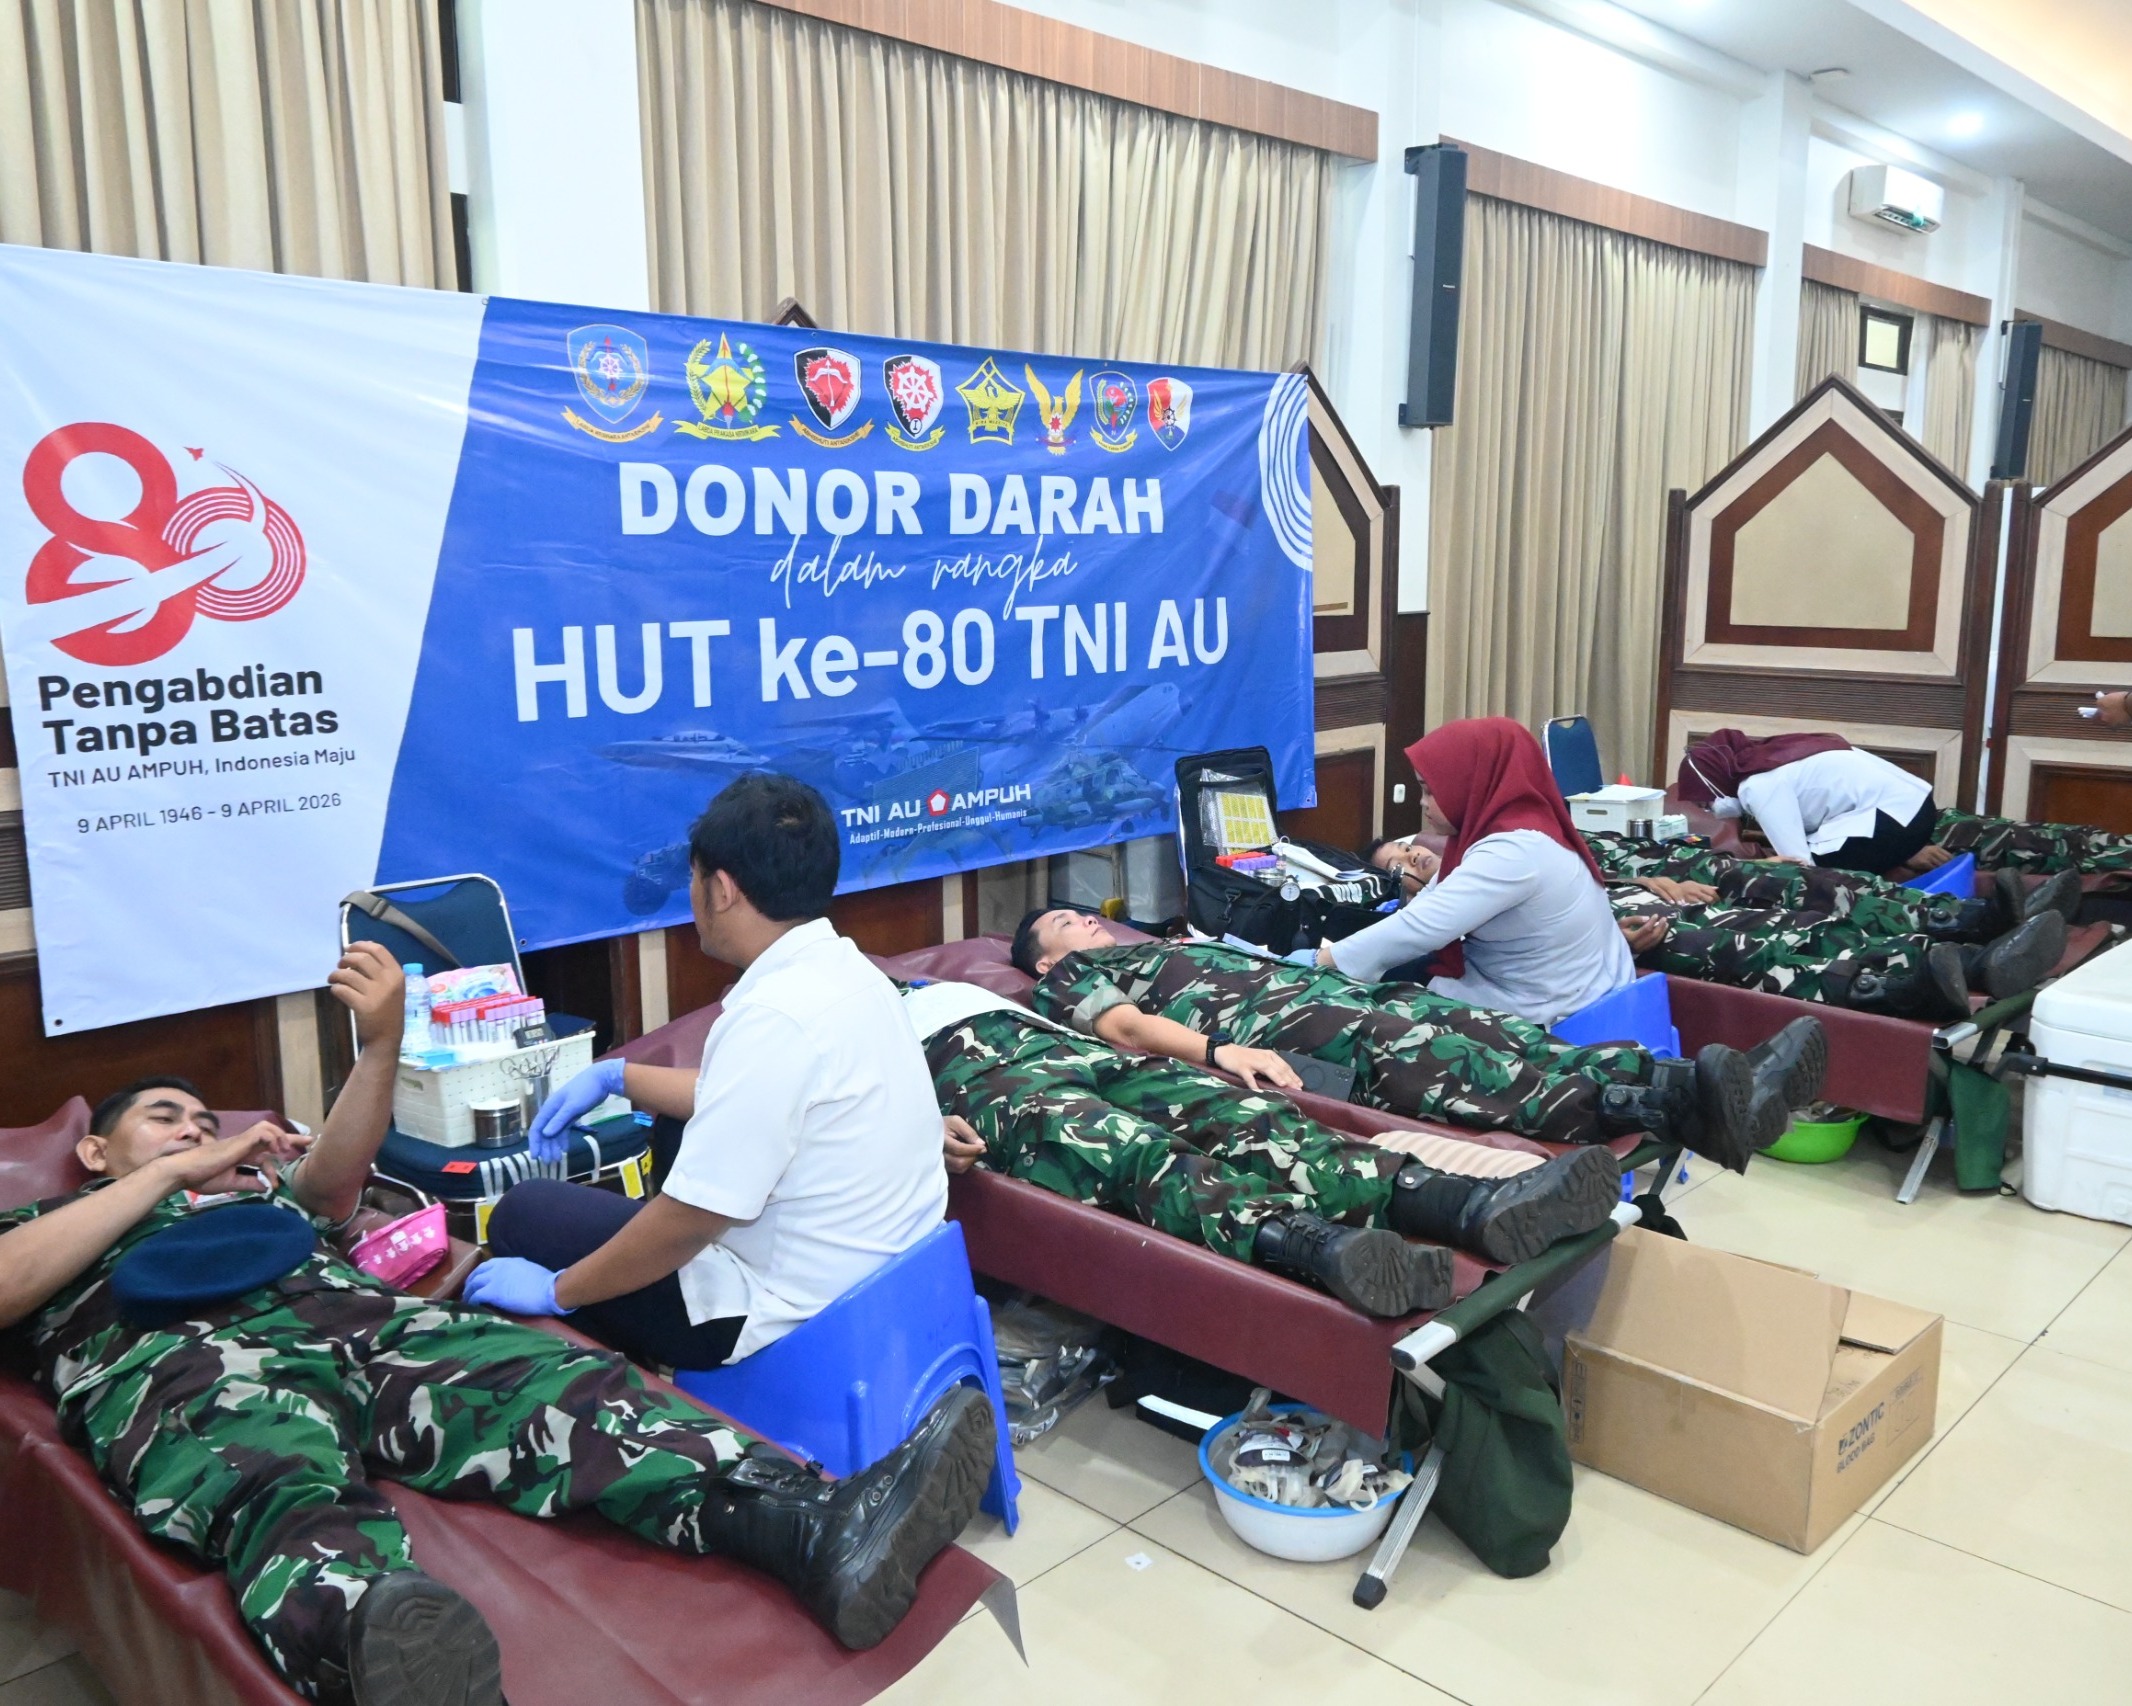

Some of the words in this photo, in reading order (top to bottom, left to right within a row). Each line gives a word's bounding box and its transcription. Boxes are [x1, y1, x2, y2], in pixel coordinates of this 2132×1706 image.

[620, 462, 922, 535] DONOR
[948, 473, 1163, 534] DARAH
[770, 533, 906, 609] dalam
[931, 533, 1077, 621] rangka
[513, 620, 730, 721] HUT
[760, 608, 994, 702] ke-80
[1016, 602, 1127, 678] TNI
[1148, 598, 1228, 670] AU
[38, 664, 323, 714] Pengabdian
[43, 719, 197, 757] Tanpa
[211, 708, 339, 743] Batas
[48, 770, 85, 788] TNI
[93, 767, 121, 784] AU
[128, 761, 210, 781] AMPUH,
[216, 755, 310, 773] Indonesia
[315, 750, 355, 766] Maju
[78, 818, 89, 834] 9
[95, 813, 155, 832] APRIL
[160, 807, 203, 824] 1946
[221, 804, 232, 818] 9
[238, 799, 294, 817] APRIL
[299, 793, 342, 811] 2026
[841, 804, 880, 827] TNI
[888, 800, 921, 821] AU
[952, 784, 1032, 811] AMPUH
